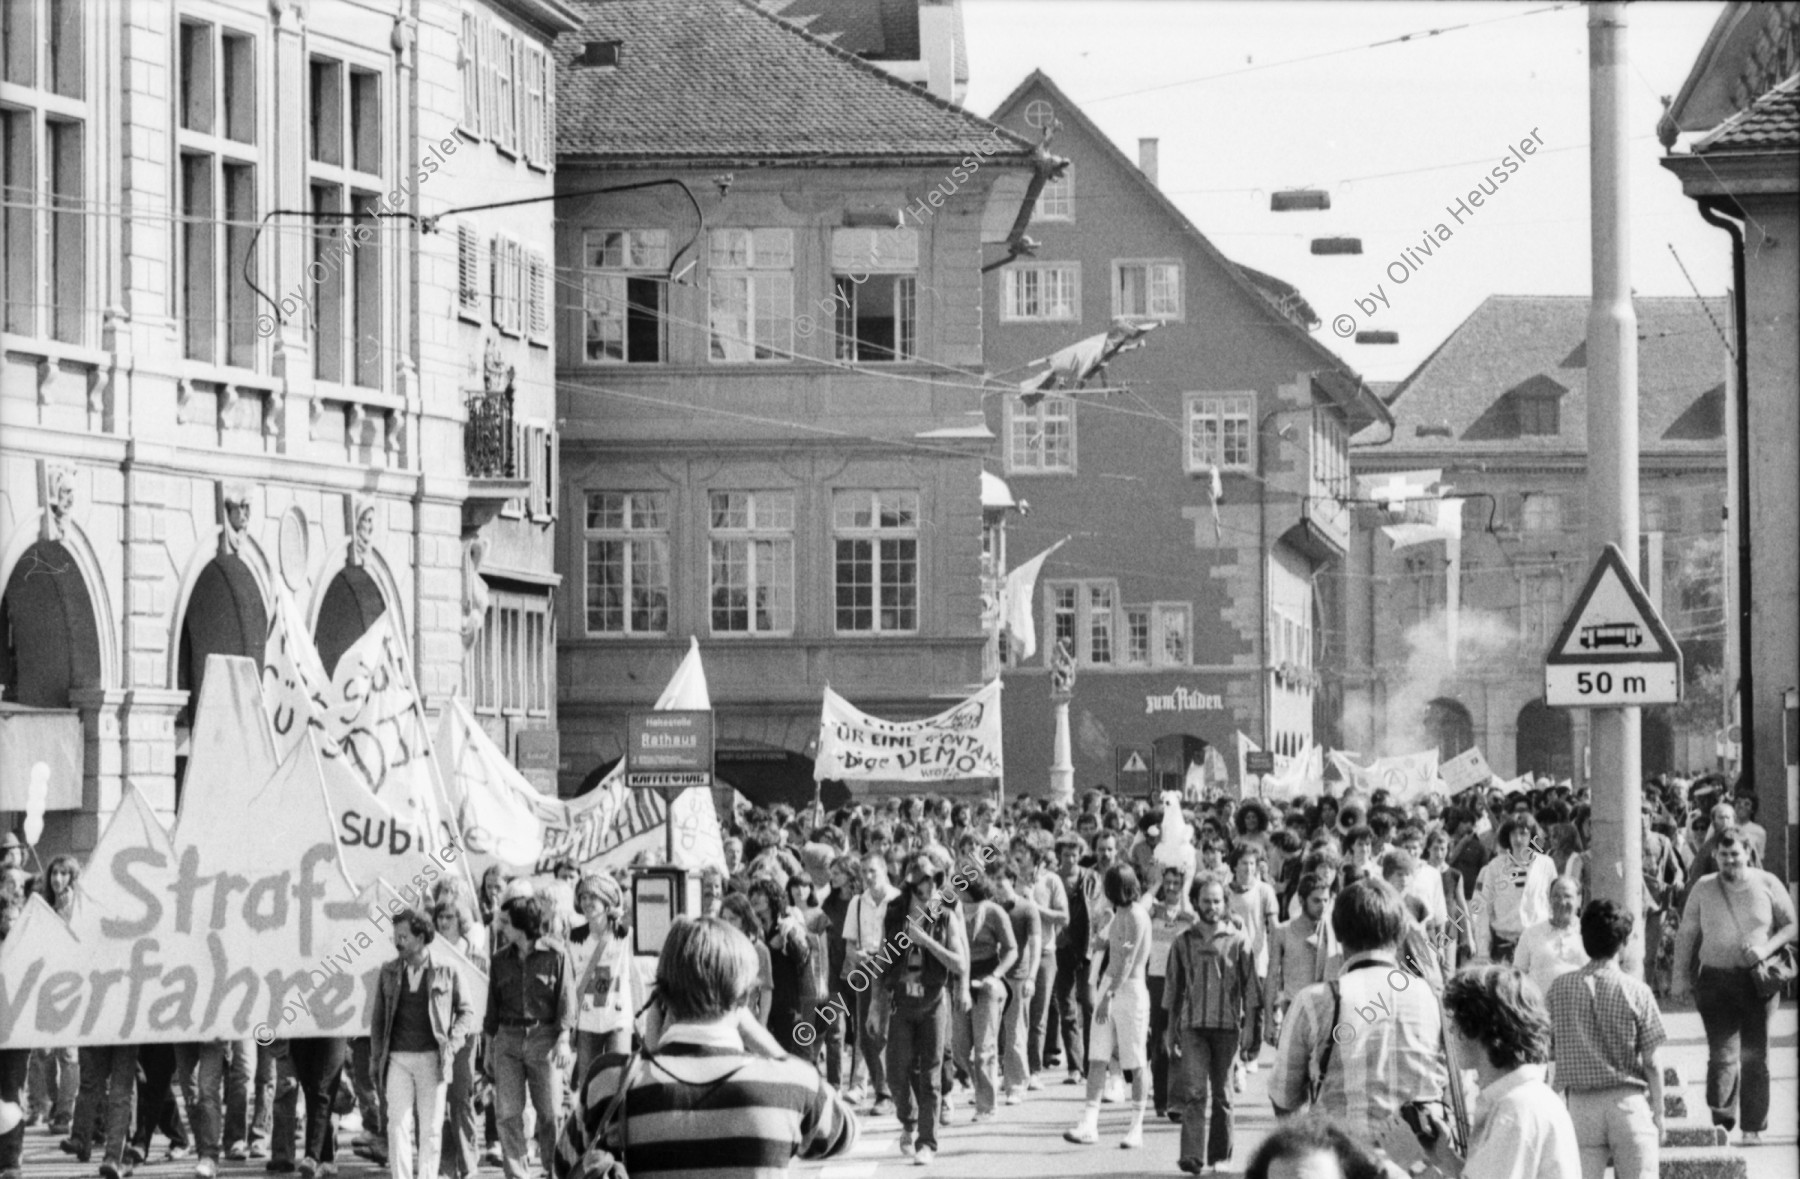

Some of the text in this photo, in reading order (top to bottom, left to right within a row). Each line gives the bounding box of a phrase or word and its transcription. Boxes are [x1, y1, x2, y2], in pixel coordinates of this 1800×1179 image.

[1577, 671, 1646, 695] 50 m
[641, 732, 697, 749] Rathaus
[871, 733, 916, 748] EINE
[897, 746, 977, 773] DEMO
[632, 775, 669, 785] KAFFEE
